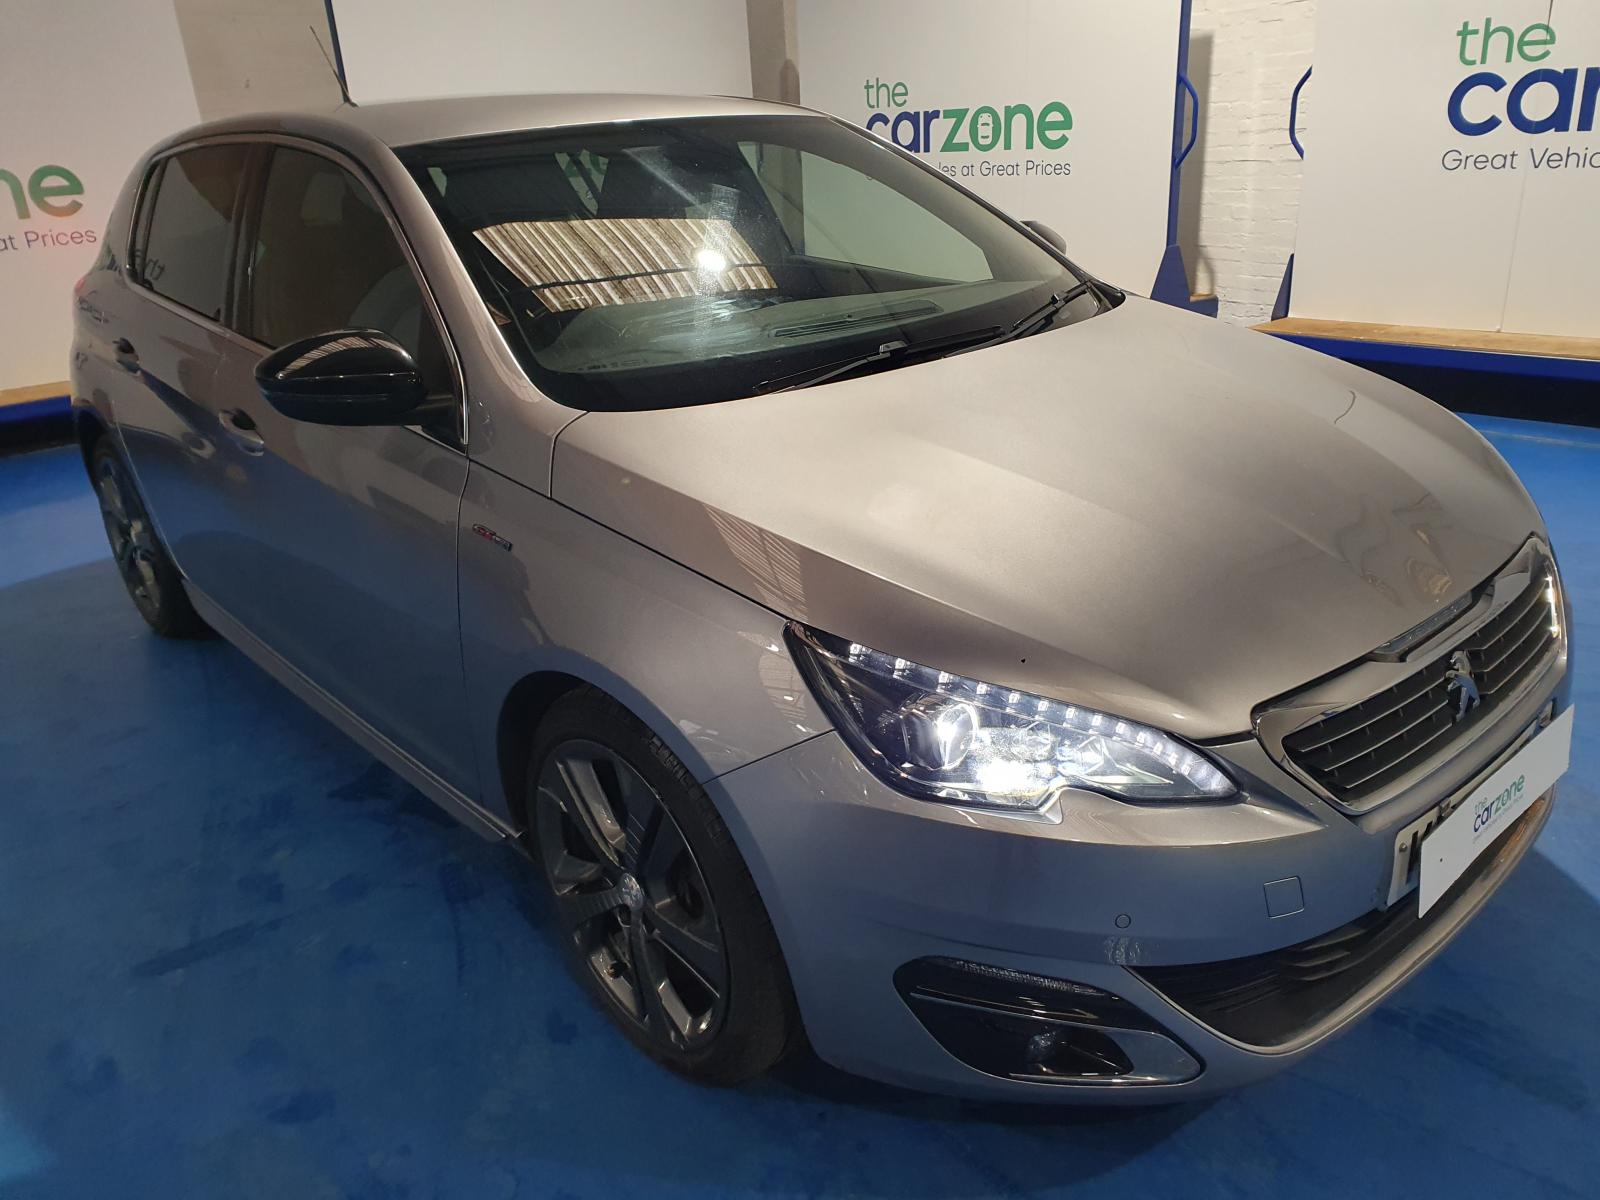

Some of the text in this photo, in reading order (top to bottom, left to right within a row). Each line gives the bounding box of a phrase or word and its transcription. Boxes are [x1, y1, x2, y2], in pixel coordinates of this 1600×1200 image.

[1456, 17, 1556, 66] the
[864, 78, 908, 108] the
[961, 163, 975, 177] at
[979, 160, 1020, 177] Great
[1025, 159, 1072, 176] Prices
[1441, 149, 1519, 171] Great
[24, 229, 97, 248] Prices
[1473, 774, 1525, 833] carzone
